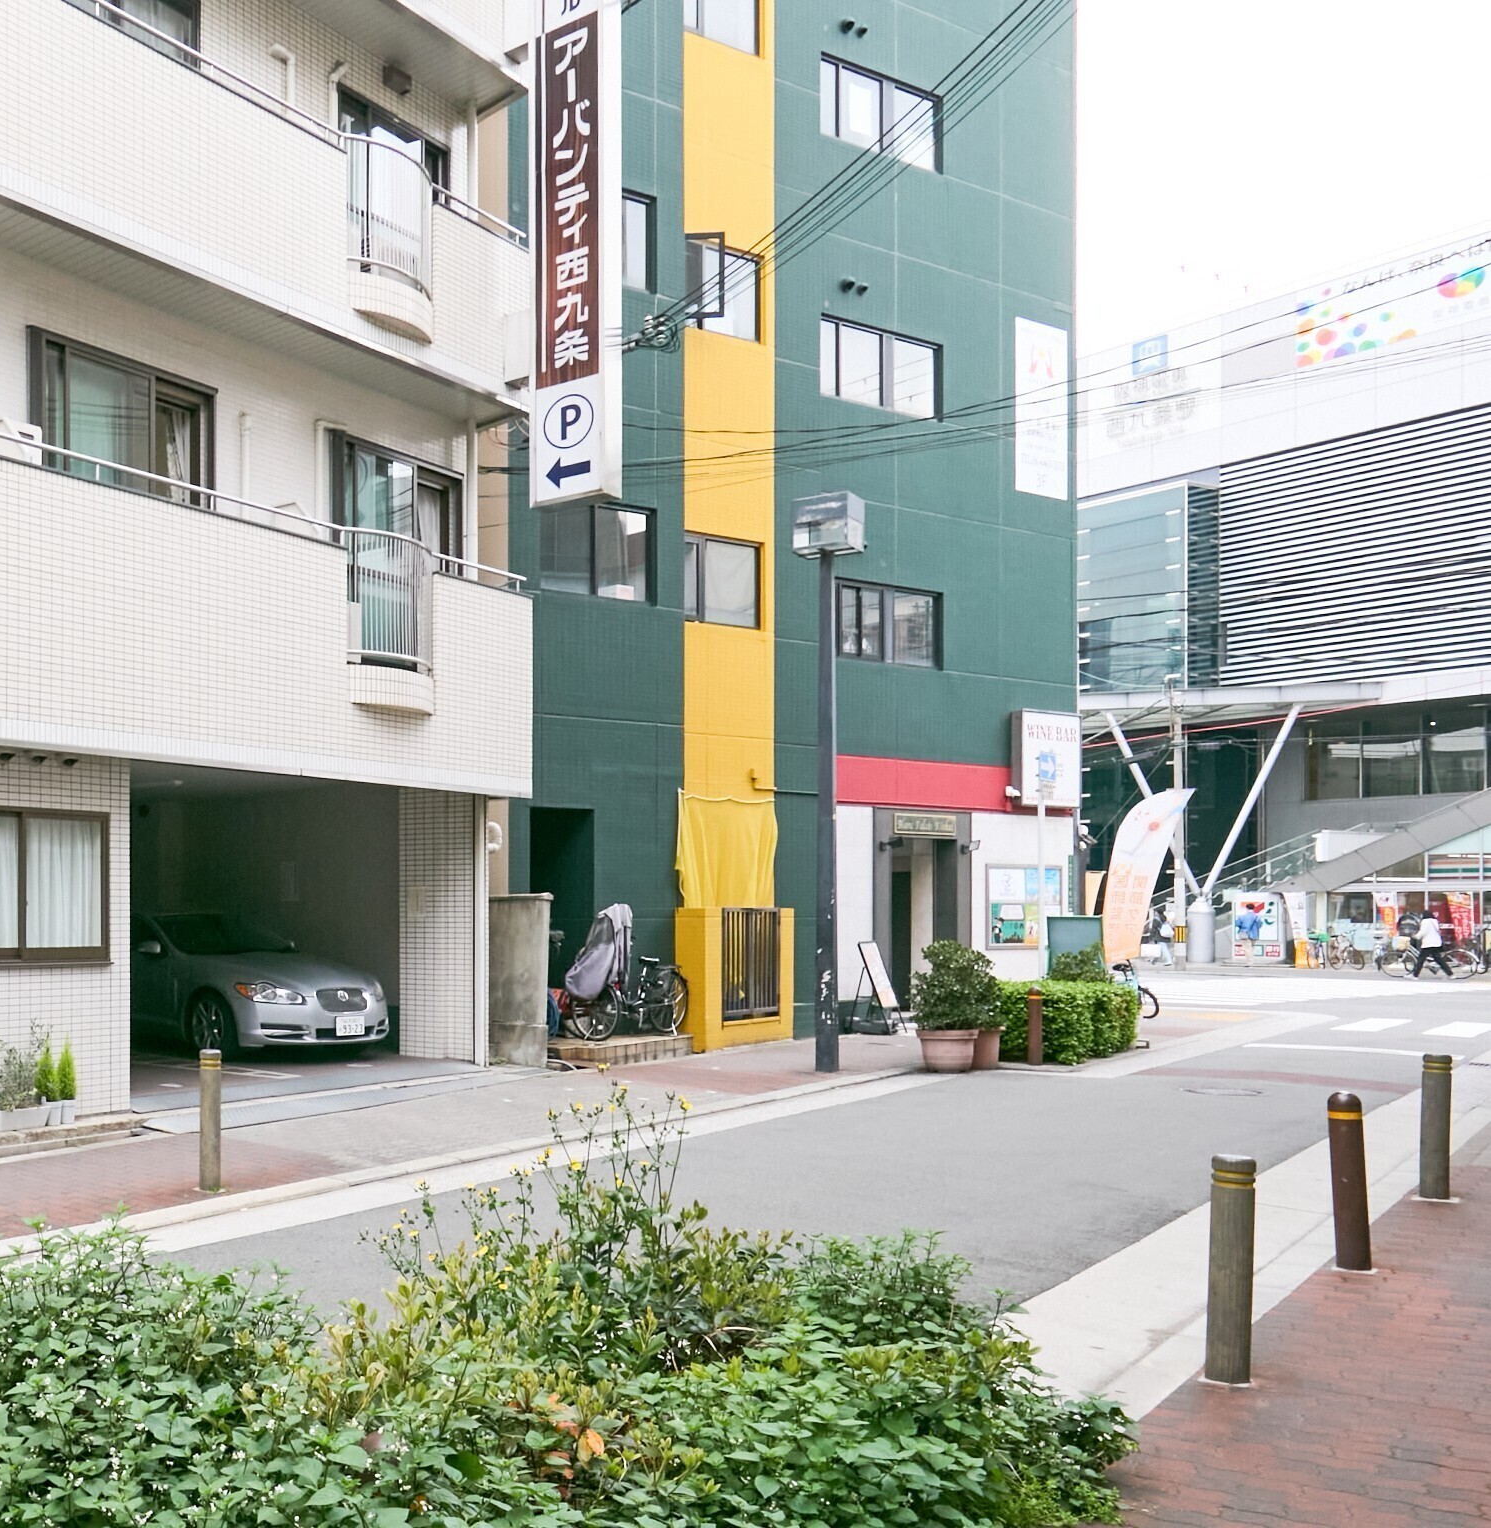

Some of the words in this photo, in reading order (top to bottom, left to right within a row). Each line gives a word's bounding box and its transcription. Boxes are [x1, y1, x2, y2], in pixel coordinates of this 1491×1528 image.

[552, 26, 591, 369] アーバンティ西九条
[1341, 237, 1491, 296] なんば、奈良へは
[560, 403, 582, 441] P
[1026, 723, 1054, 741] WINE
[1055, 726, 1078, 743] BAR
